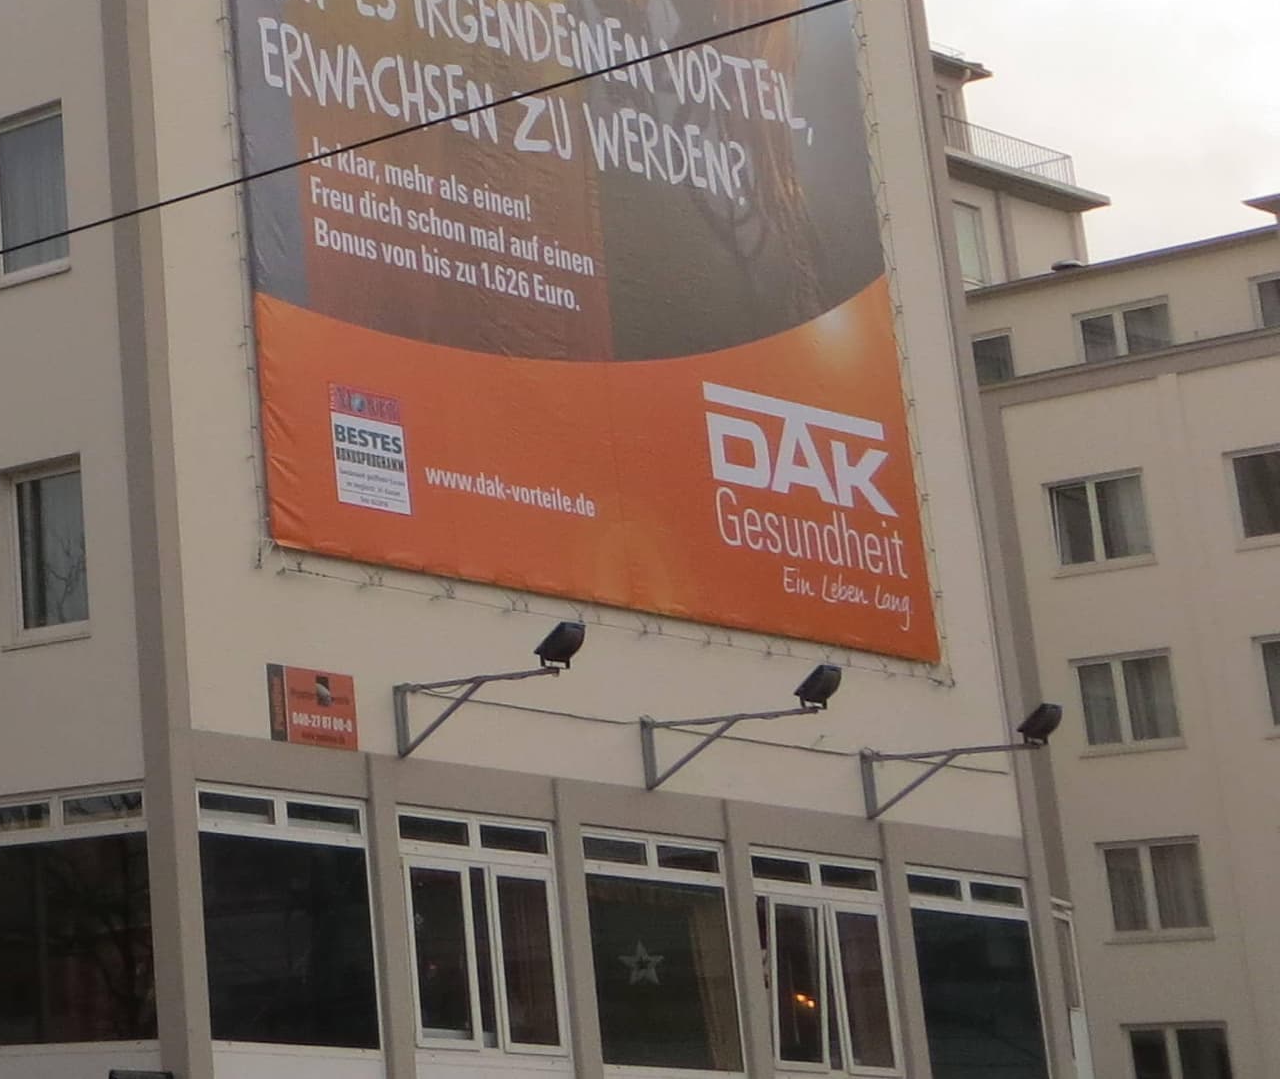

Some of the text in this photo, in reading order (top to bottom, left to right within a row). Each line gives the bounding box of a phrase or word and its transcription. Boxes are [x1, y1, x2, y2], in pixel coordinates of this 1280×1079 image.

[258, 17, 746, 207] ERWACHSEN ZU WERDEN?
[306, 136, 532, 222] Ja klar, mehr als einen!
[310, 175, 594, 277] Freu dich schon mal auf einen
[314, 217, 581, 311] Bonus von bis zu 1.626 Euro.
[334, 423, 403, 454] BESTES
[702, 381, 899, 518] DAK
[425, 467, 596, 517] www.dak-vorteile.de
[716, 487, 909, 579] Gesundheit
[783, 566, 815, 595] Ein
[822, 574, 868, 605] Leben
